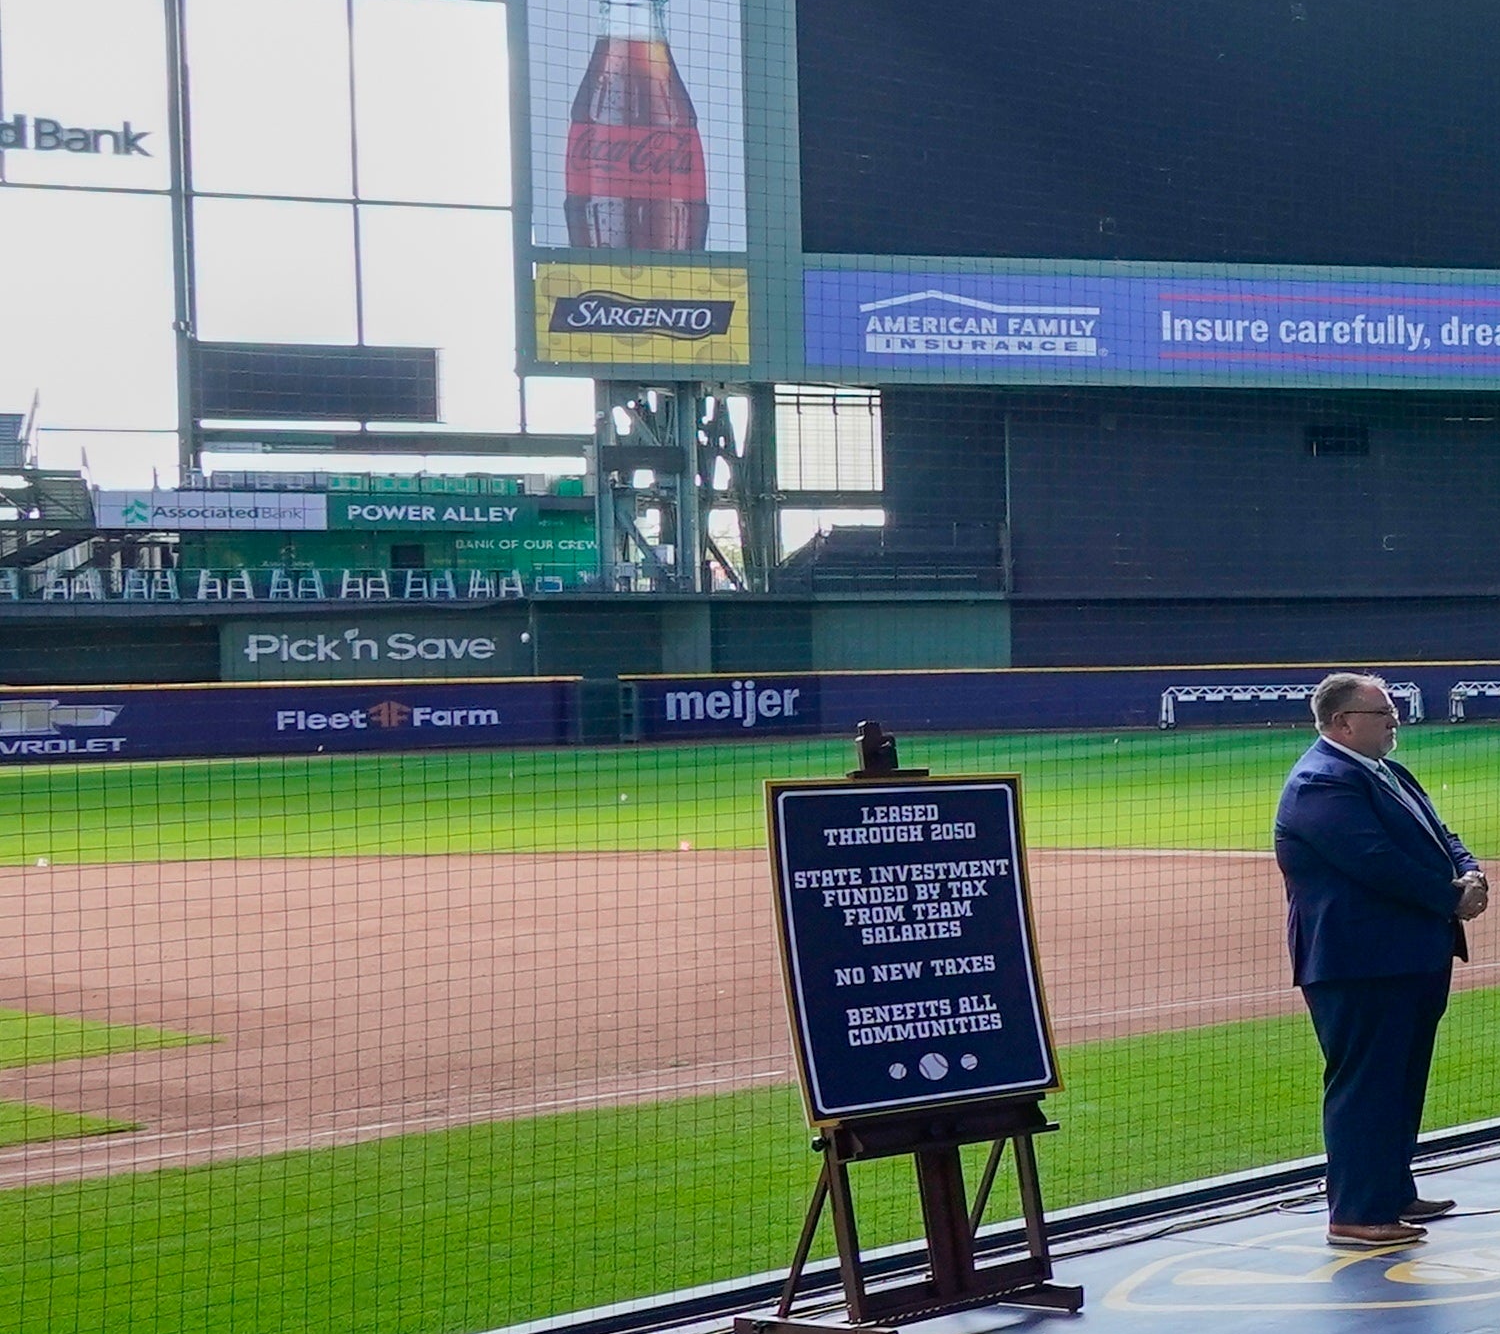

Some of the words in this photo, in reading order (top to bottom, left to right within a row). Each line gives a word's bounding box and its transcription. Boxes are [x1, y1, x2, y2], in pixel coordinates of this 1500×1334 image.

[35, 119, 155, 157] Bank
[571, 126, 698, 176] Coca-Cola
[567, 299, 713, 331] SARGENTO
[867, 316, 998, 334] AMERICAN
[1008, 317, 1096, 336] FAMILY
[1160, 310, 1269, 344] Insure
[1279, 310, 1432, 351] carefully,
[884, 338, 1080, 352] INSURANCE
[152, 504, 259, 522] Associated
[262, 505, 303, 521] Bank
[347, 504, 437, 523] POWER
[443, 505, 518, 523] ALLEY
[455, 539, 495, 550] BANK
[501, 539, 519, 550] OF
[524, 539, 560, 550] OUR
[245, 633, 340, 663] Pick
[387, 633, 495, 661] Save
[277, 710, 367, 731] Fleet
[412, 706, 501, 728] Farm
[665, 682, 800, 727] meijer
[861, 805, 939, 823] LEASED
[824, 826, 924, 846] THROUGH
[931, 824, 977, 840] 2050
[795, 868, 862, 888] STATE
[870, 859, 1010, 884] INVESTMENT
[822, 885, 907, 907] FUNDED
[916, 884, 940, 900] BY
[948, 880, 988, 897] TAX
[844, 904, 905, 926] FROM
[913, 901, 973, 920] TEAM
[862, 922, 962, 945] SALARIES
[835, 967, 865, 986] NO
[872, 961, 923, 982] NEW
[931, 955, 996, 977] TAXES
[846, 998, 952, 1026] BENEFITS
[958, 995, 997, 1012] ALL
[848, 1014, 1002, 1046] COMMUNITIES
